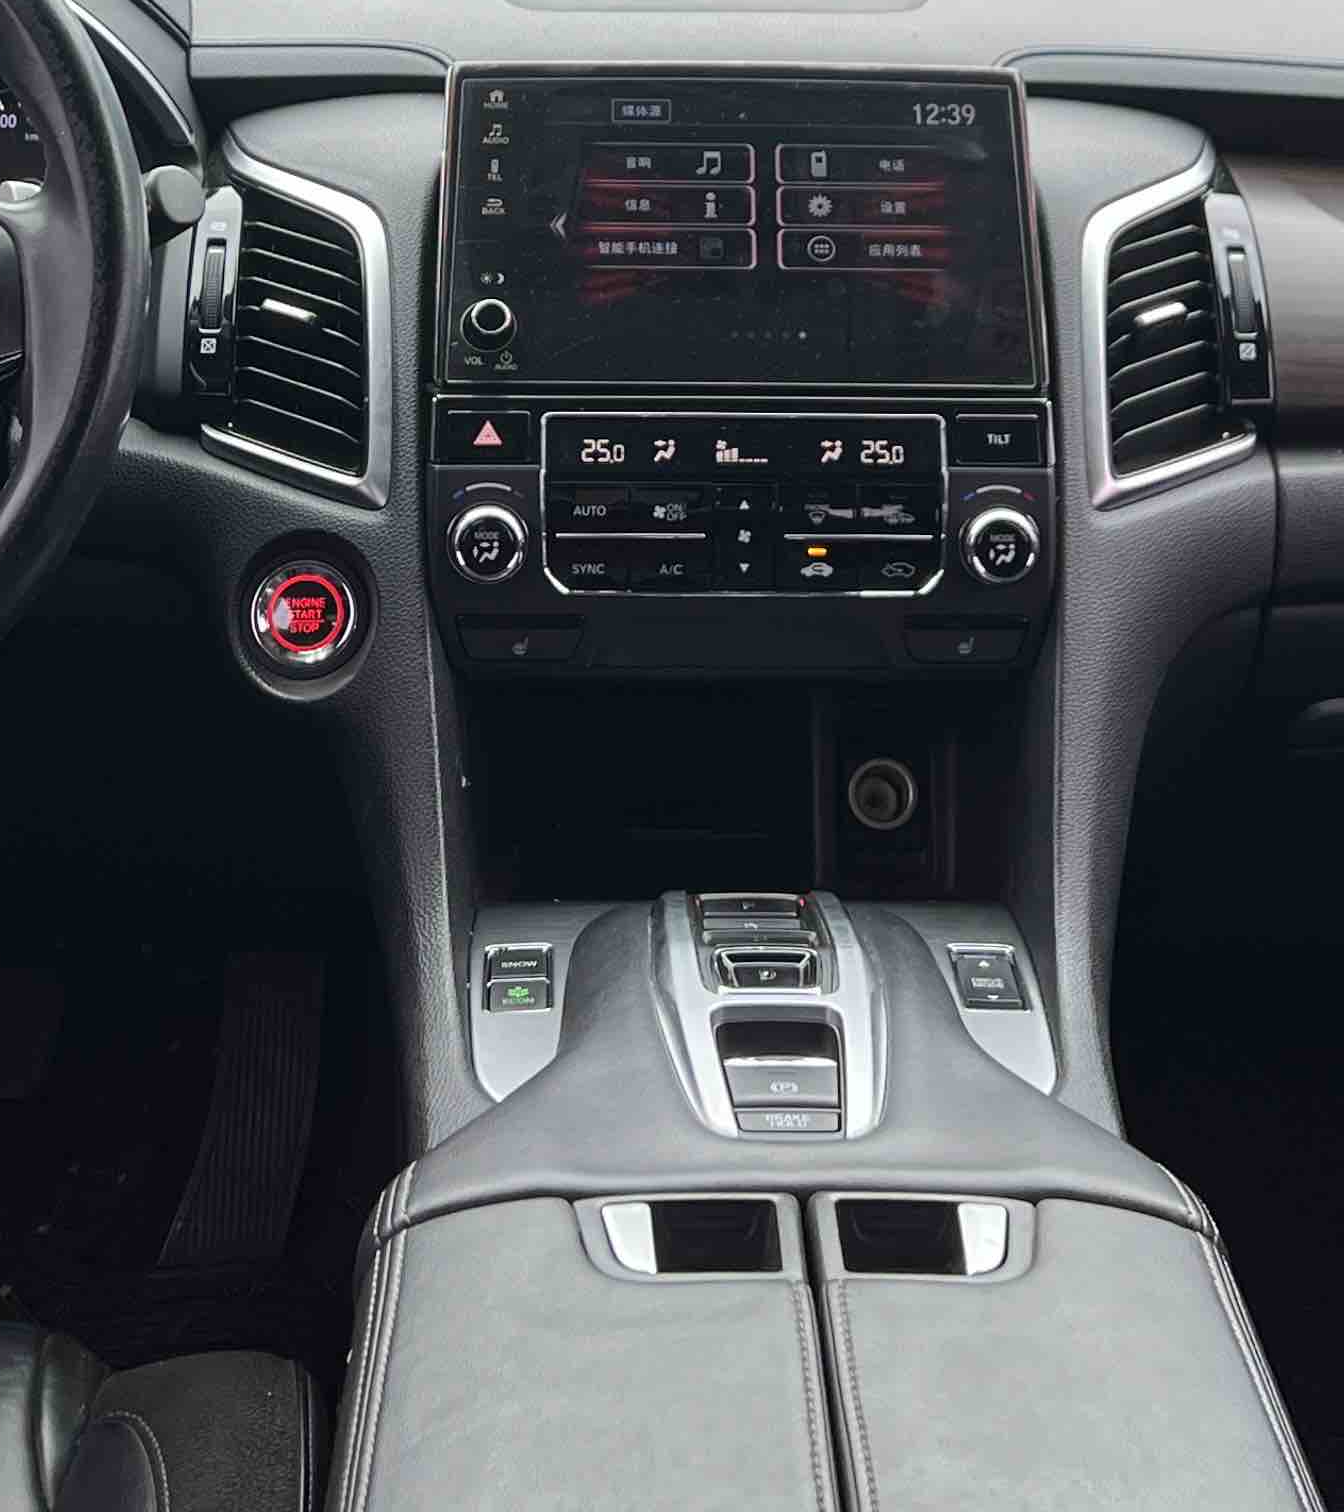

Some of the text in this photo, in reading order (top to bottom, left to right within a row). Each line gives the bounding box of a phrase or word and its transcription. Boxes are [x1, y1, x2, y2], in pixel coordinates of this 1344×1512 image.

[913, 103, 976, 126] 12:39
[482, 136, 510, 145] AUDIO
[626, 156, 652, 169] 音响
[879, 158, 905, 172] 电话
[625, 198, 651, 212] 信息
[880, 200, 906, 214] 设置
[598, 240, 678, 255] 智能手机连接
[868, 243, 923, 257] 应用列表
[464, 356, 485, 366] VOL
[986, 433, 1011, 446] TILT
[581, 439, 625, 464] 25.0
[860, 440, 904, 464] 25.0
[573, 505, 607, 517] AUTO
[571, 563, 605, 575] SYNC
[659, 563, 684, 575] A/C
[286, 597, 326, 609] ENGINE
[287, 609, 322, 620] START
[290, 623, 320, 633] STOP
